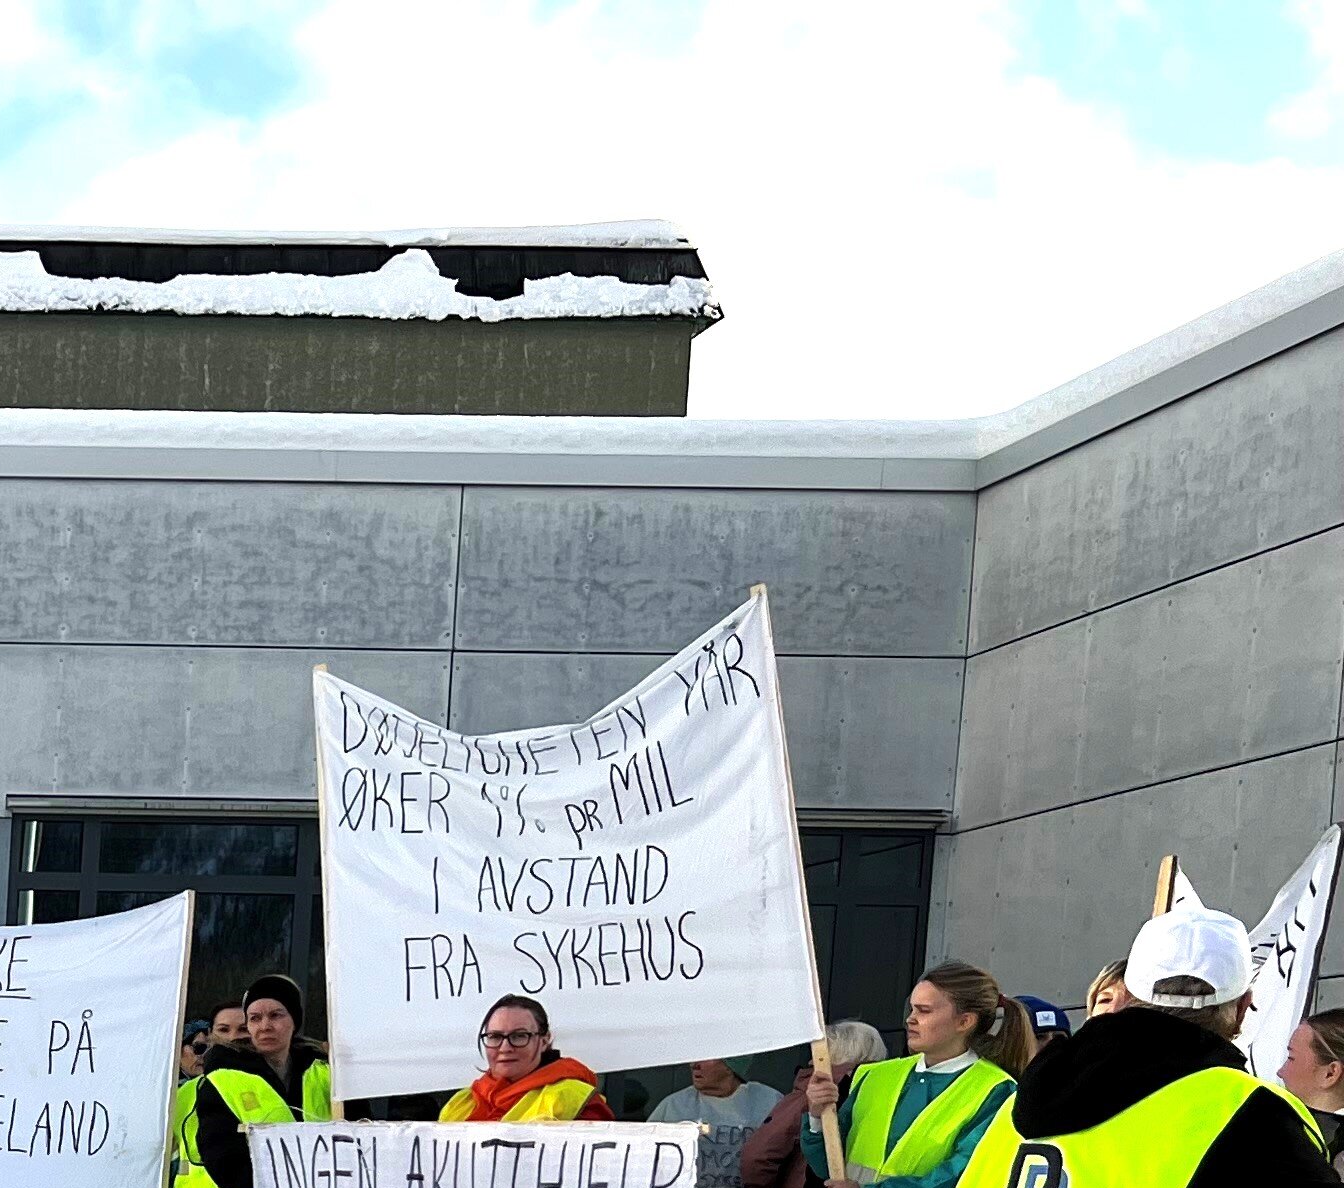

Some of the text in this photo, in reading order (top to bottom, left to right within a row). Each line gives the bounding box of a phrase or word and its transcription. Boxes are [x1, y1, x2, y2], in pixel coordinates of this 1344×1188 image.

[338, 766, 452, 835] ØKER
[610, 740, 694, 826] MIL
[433, 845, 668, 914] I AVSTAND
[405, 911, 703, 1001] FRA SYKEHUS
[49, 1010, 94, 1075] PÅ
